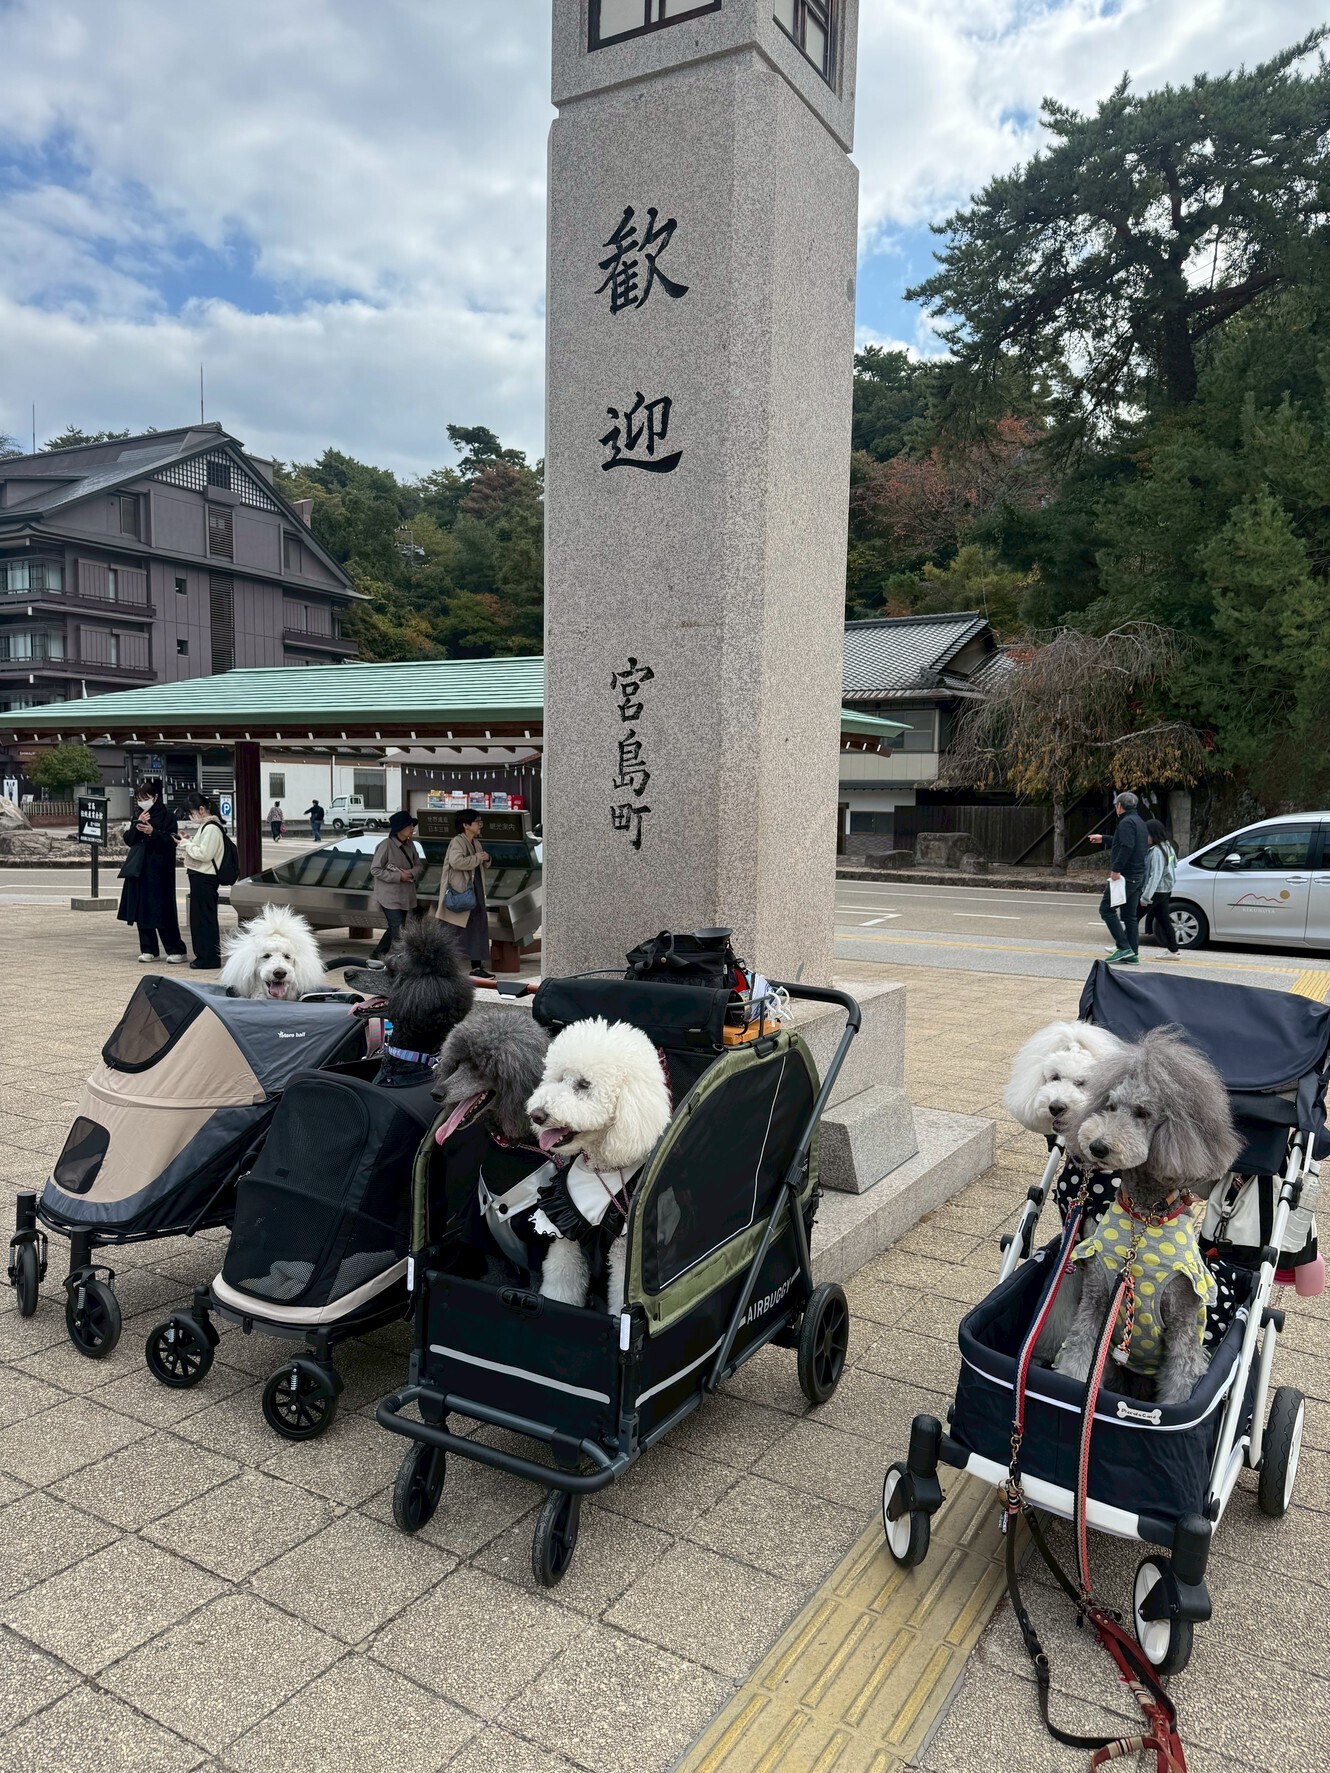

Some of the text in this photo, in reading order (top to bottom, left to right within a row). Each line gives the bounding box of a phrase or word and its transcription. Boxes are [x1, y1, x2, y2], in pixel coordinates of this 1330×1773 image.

[595, 205, 690, 474] 歓迎
[611, 657, 656, 851] 宮島町
[747, 1277, 792, 1325] AIRBUGGY
